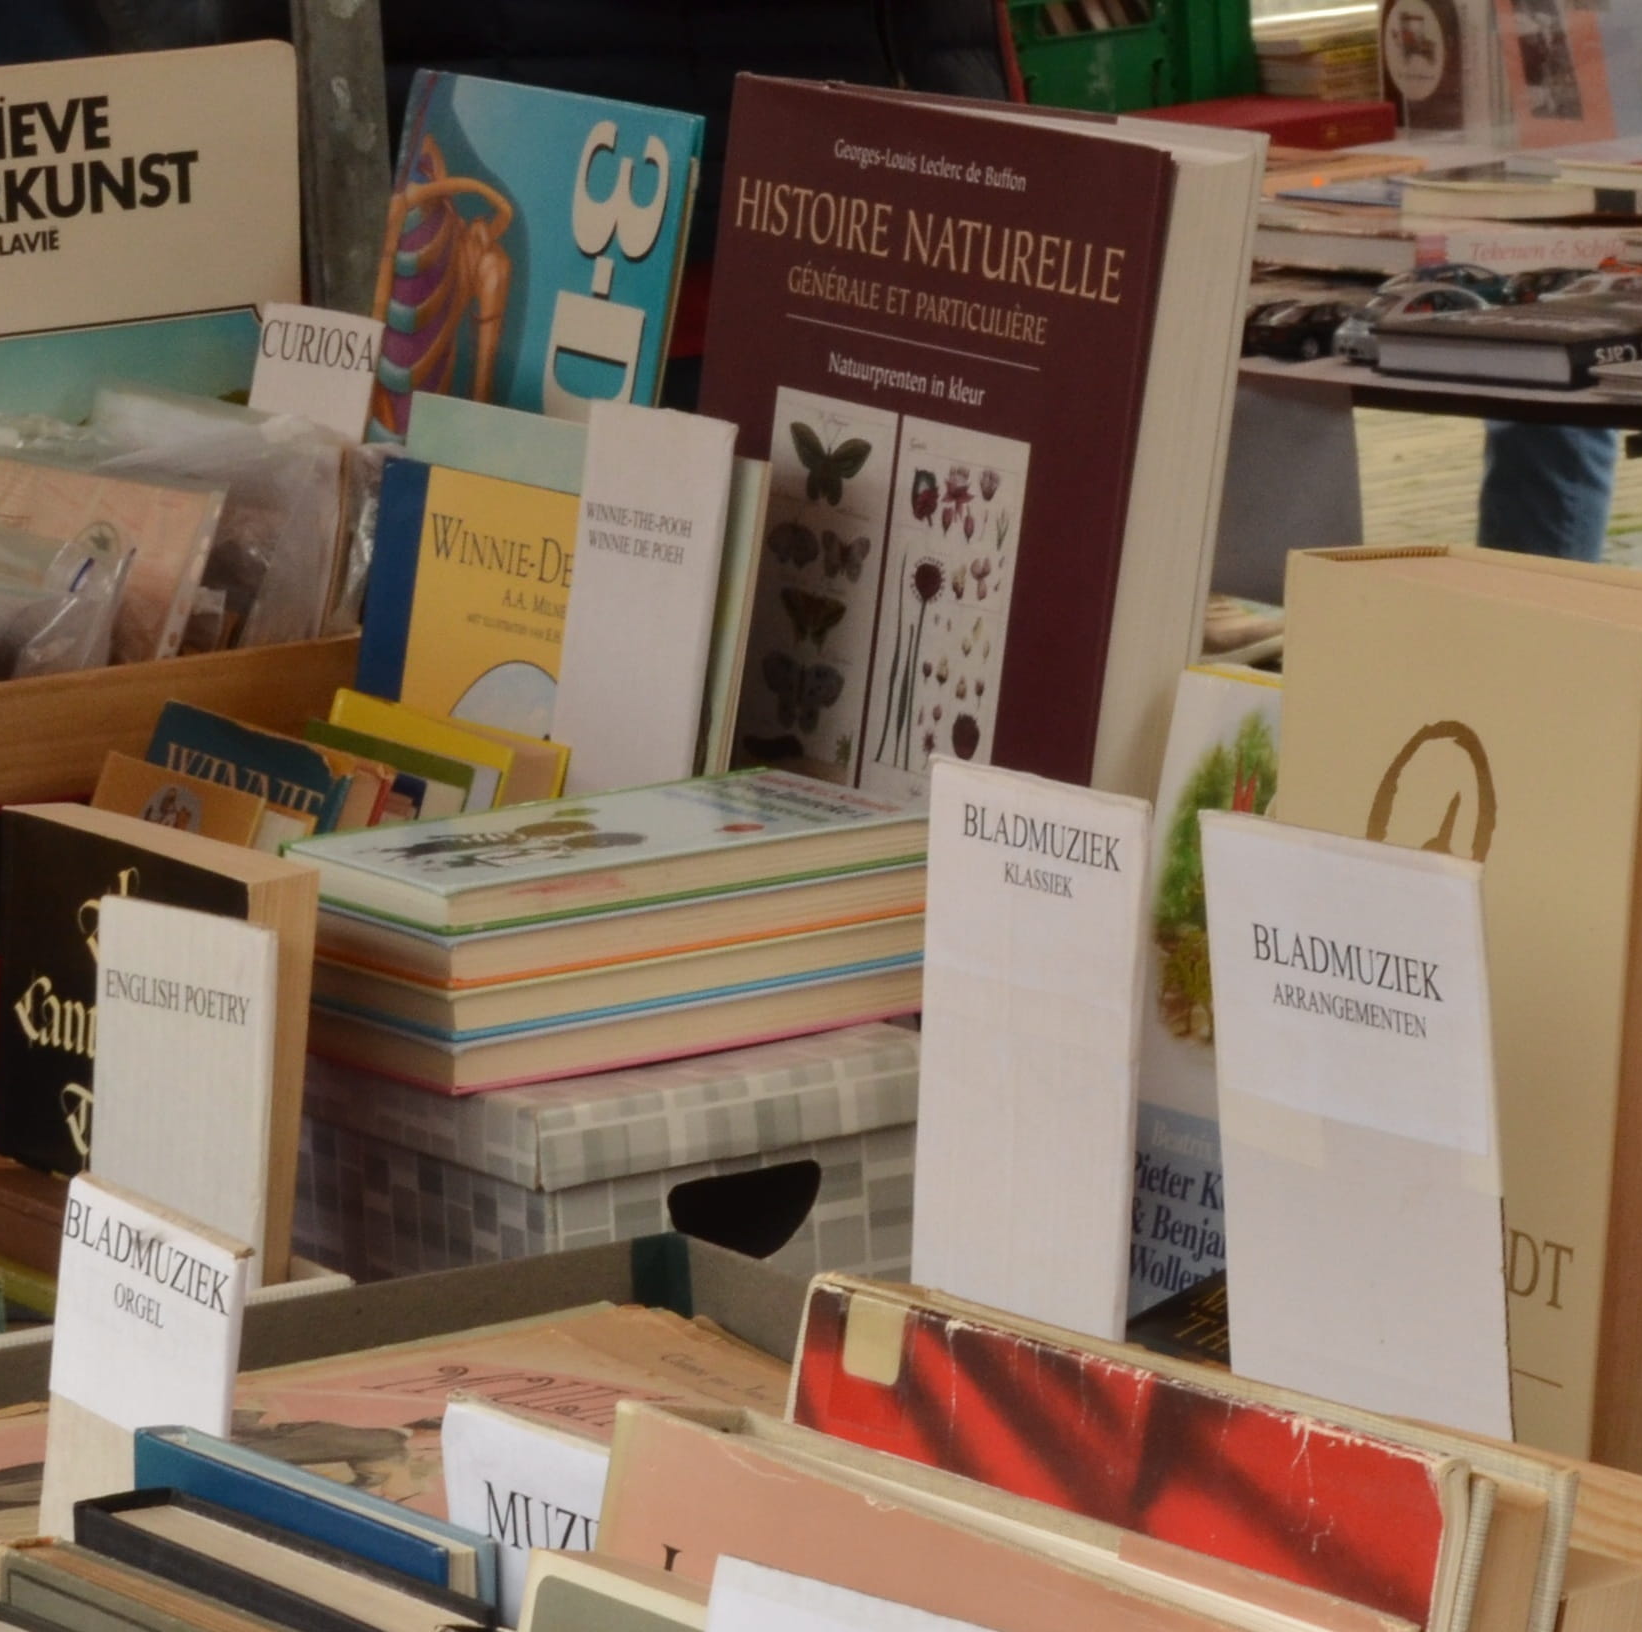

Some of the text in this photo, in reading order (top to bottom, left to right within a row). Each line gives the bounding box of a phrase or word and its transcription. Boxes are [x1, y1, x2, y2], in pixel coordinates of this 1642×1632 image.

[834, 138, 1026, 192] Georges-Louis Leclerc de Buffon
[735, 177, 1125, 304] HISTOIRE NATURELLE
[787, 261, 1048, 345] GÉNÉRALE ET PARTICULIÈRE
[262, 318, 376, 373] CURIOSA
[828, 351, 986, 406] Natuurprenten in kleur
[586, 501, 692, 538] WINNIE-THE-POOH
[588, 529, 684, 565] WINNIE DE POEH
[963, 803, 1121, 873] BLADMUZIEK
[1004, 862, 1074, 899] KLASSIEK
[1252, 923, 1443, 1002] BLADMUZIEK
[105, 968, 251, 1027] ENGLISH POETRY
[1272, 982, 1427, 1039] ARRANGEMENTEN
[64, 1199, 230, 1317] BLADMUZIEK
[114, 1282, 164, 1329] ORGEL
[483, 1480, 600, 1551] MUZI
